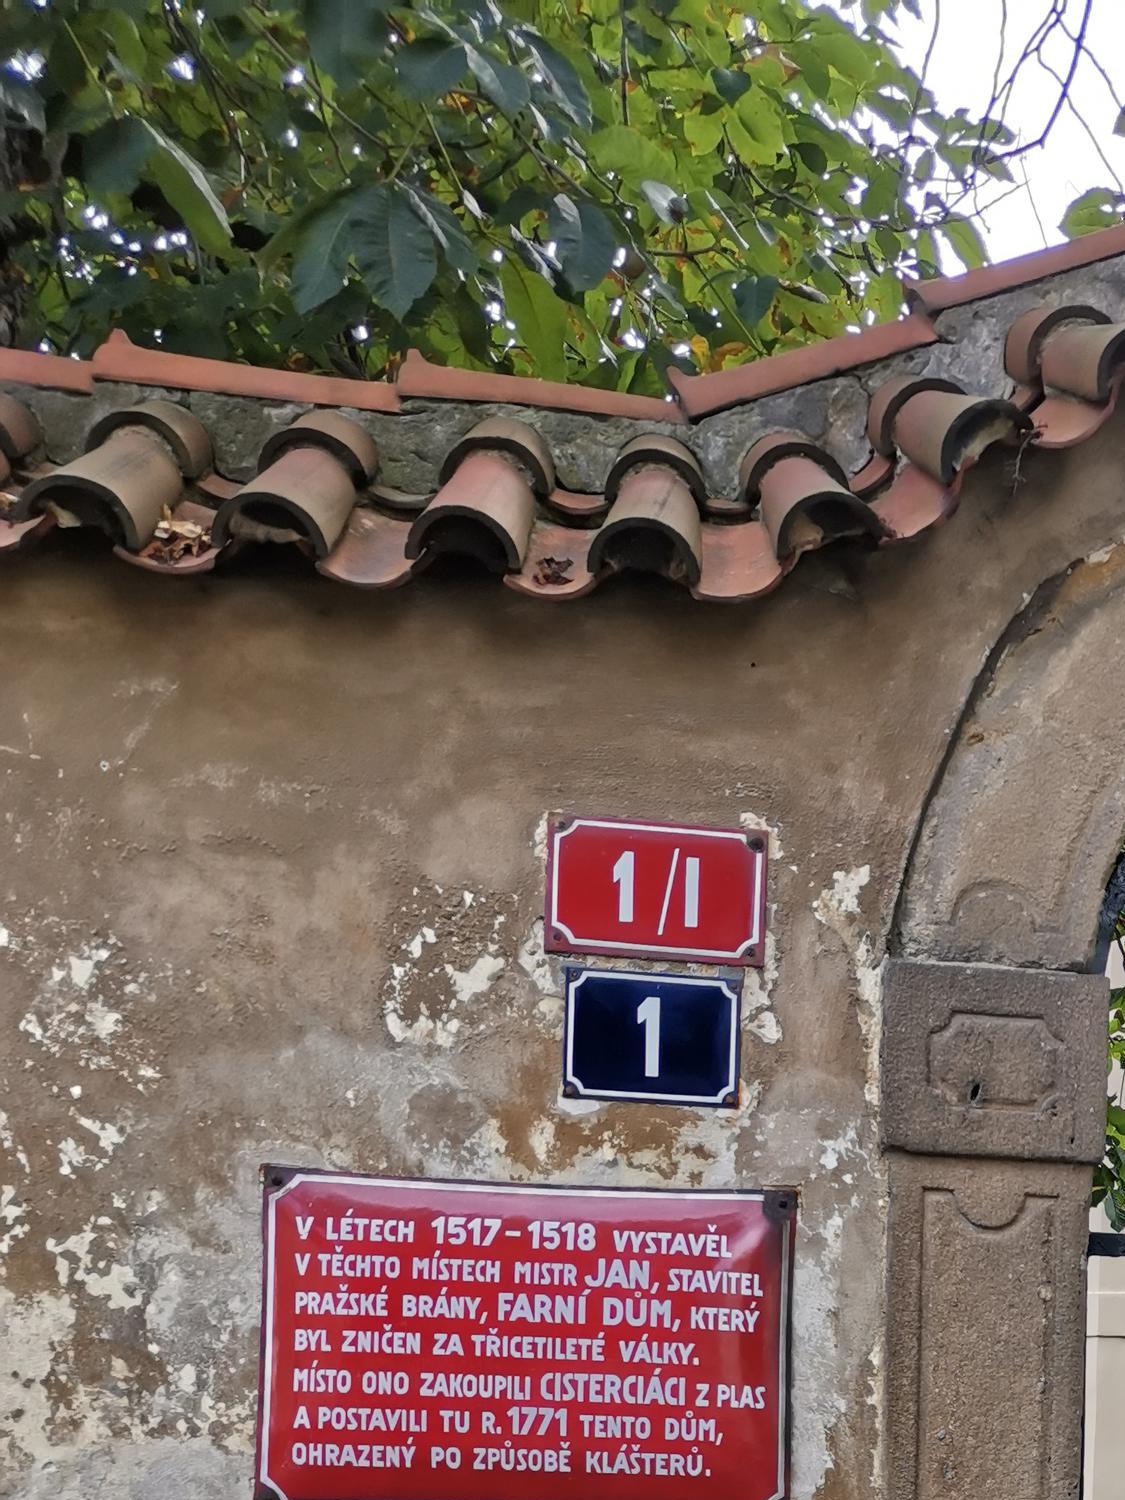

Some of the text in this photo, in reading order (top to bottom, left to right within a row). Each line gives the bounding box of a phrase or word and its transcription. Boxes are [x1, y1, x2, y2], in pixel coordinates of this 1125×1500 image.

[637, 997, 661, 1078] 1
[296, 1216, 314, 1239] V
[326, 1212, 414, 1242] LÉTECH
[613, 1224, 732, 1257] VYSTAVĚL
[295, 1246, 763, 1297] V TĚCHTO MÍSTECH MISTR JAN, STAVITEL
[295, 1284, 759, 1332] PRAŽSKÉ BRÁNY, FARNÍ DŮM, KTERÝ
[295, 1324, 699, 1365] BYL ZNIČEN ZA TŘICETILETÉ VÁLKY.
[293, 1360, 765, 1409] MÍSTO ONO ZAKOUPILI CISTERCIÁCI Z PLAS
[293, 1406, 722, 1445] A POSTAVILI TU R. 1771 TENTO DŮM,
[292, 1437, 710, 1476] OHRAZENÝ PO ZPŮSOBĚ KLÁŠTERŮ.
